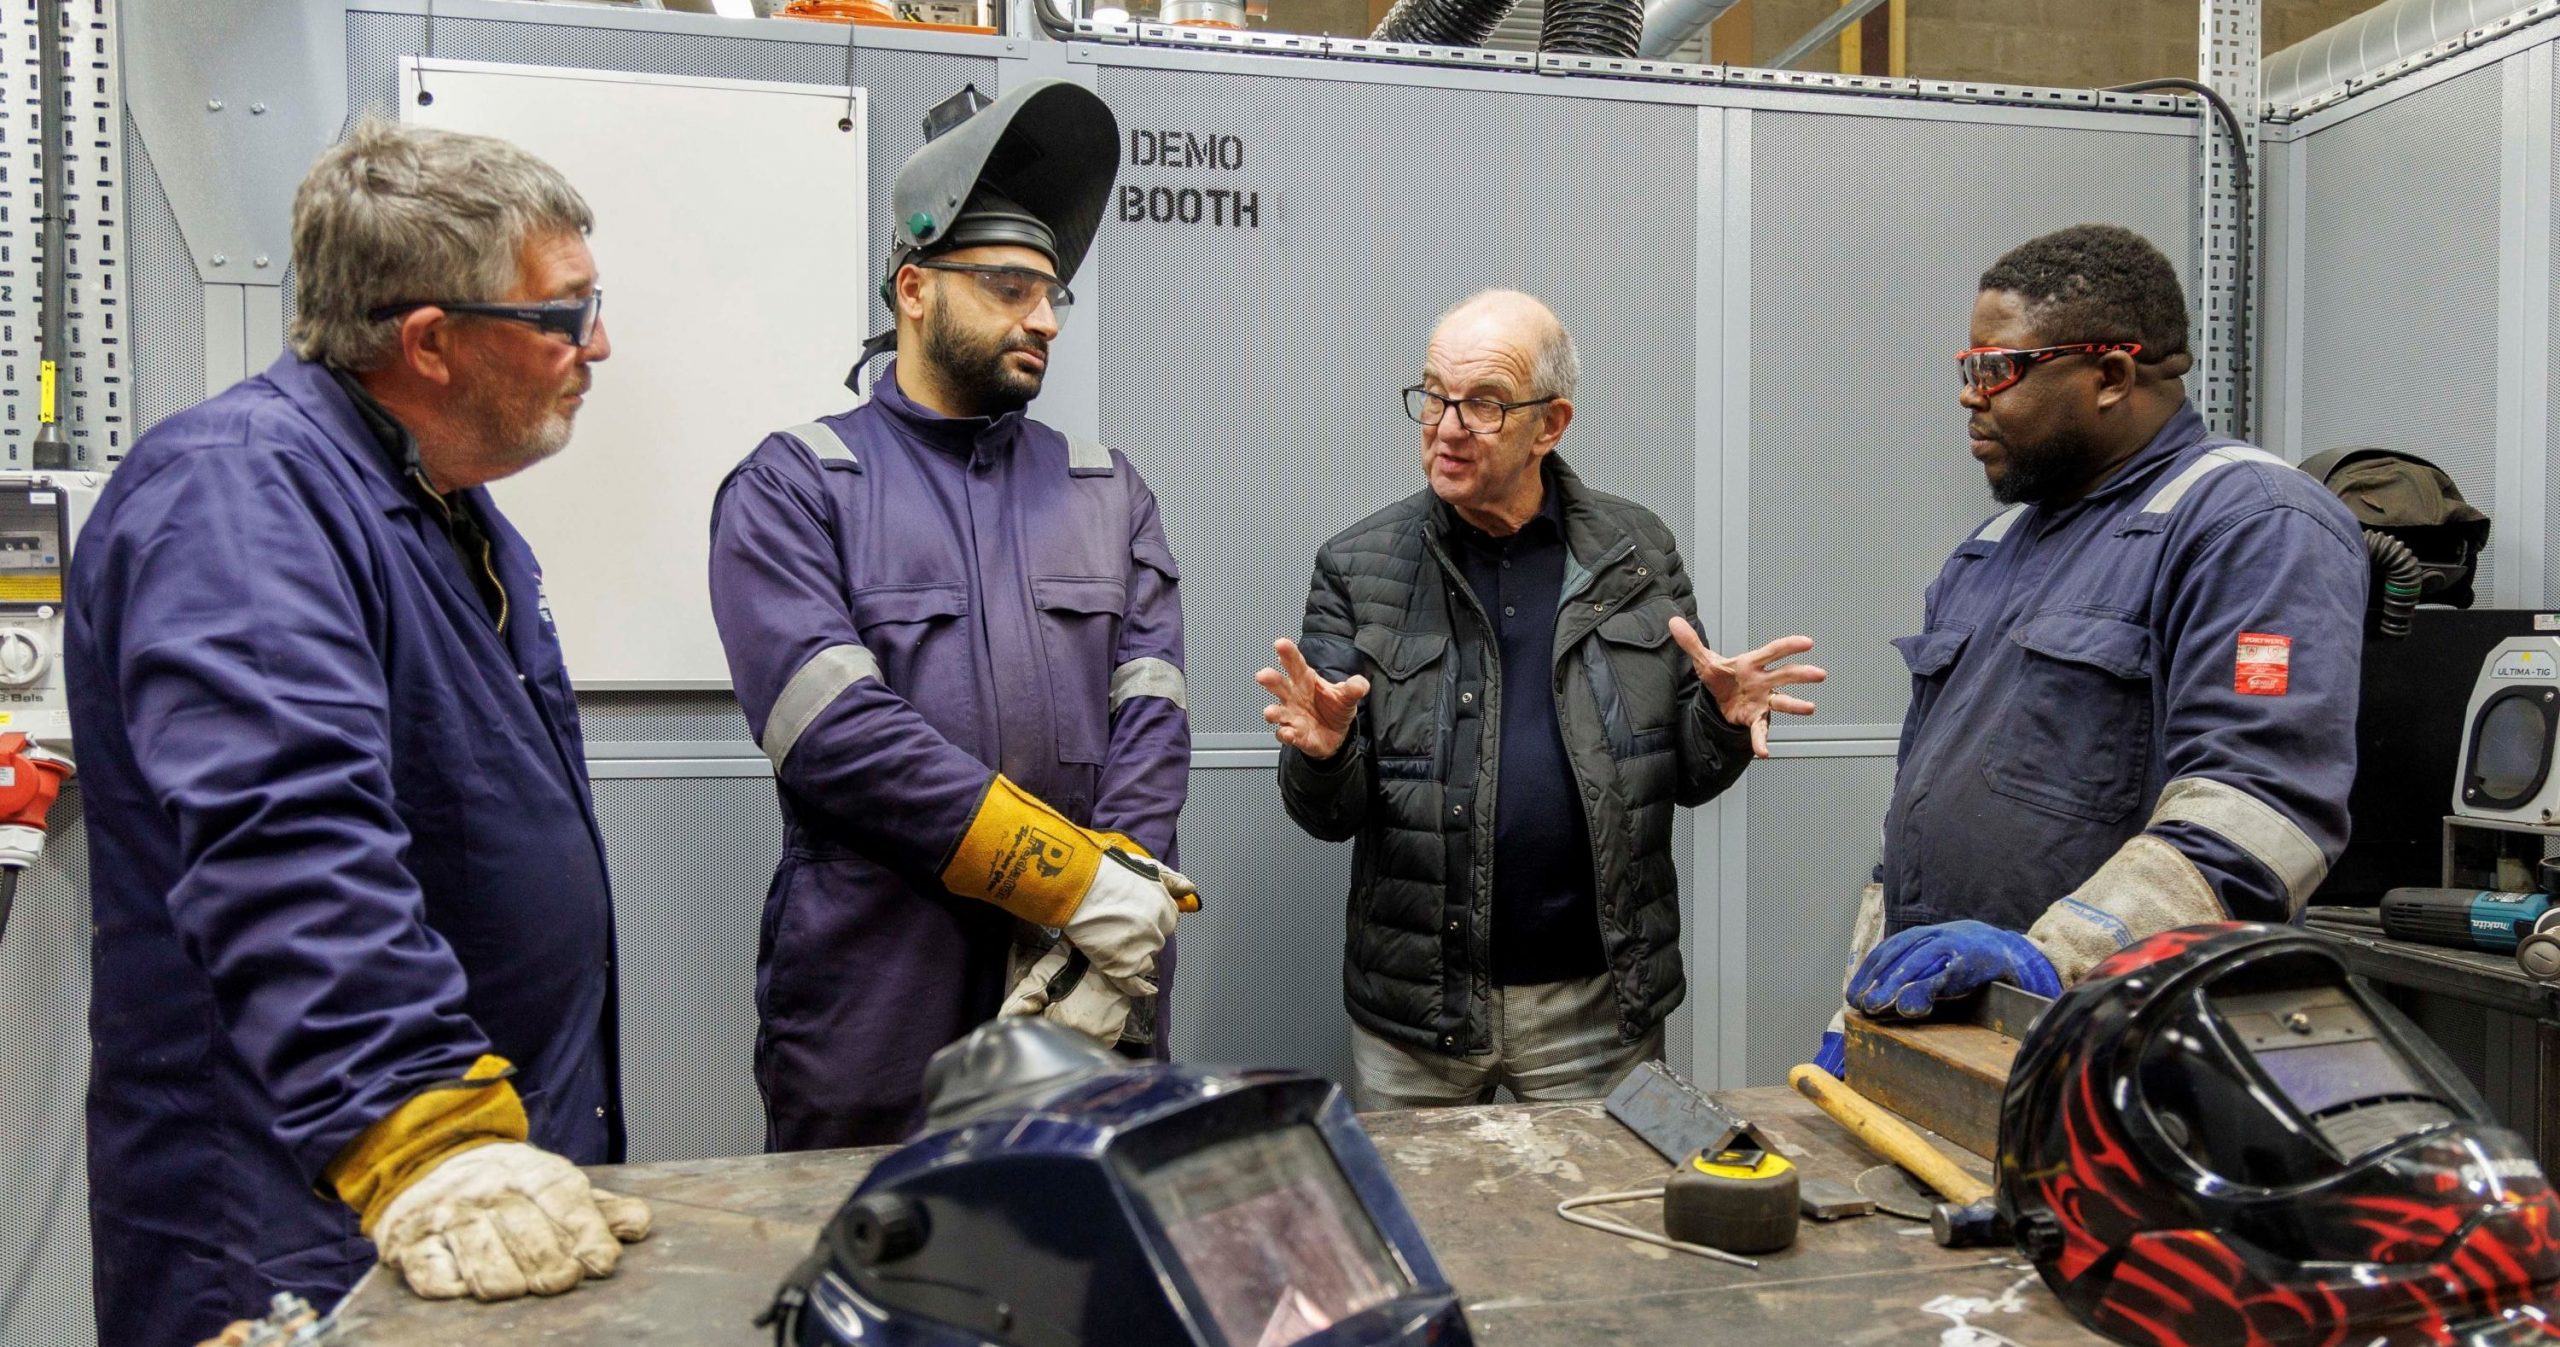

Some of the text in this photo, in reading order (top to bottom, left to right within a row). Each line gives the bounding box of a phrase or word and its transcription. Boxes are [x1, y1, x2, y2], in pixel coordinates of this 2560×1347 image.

[1131, 129, 1243, 171] DEMO
[1119, 185, 1259, 228] BOOTH
[2471, 919, 2510, 931] makita
